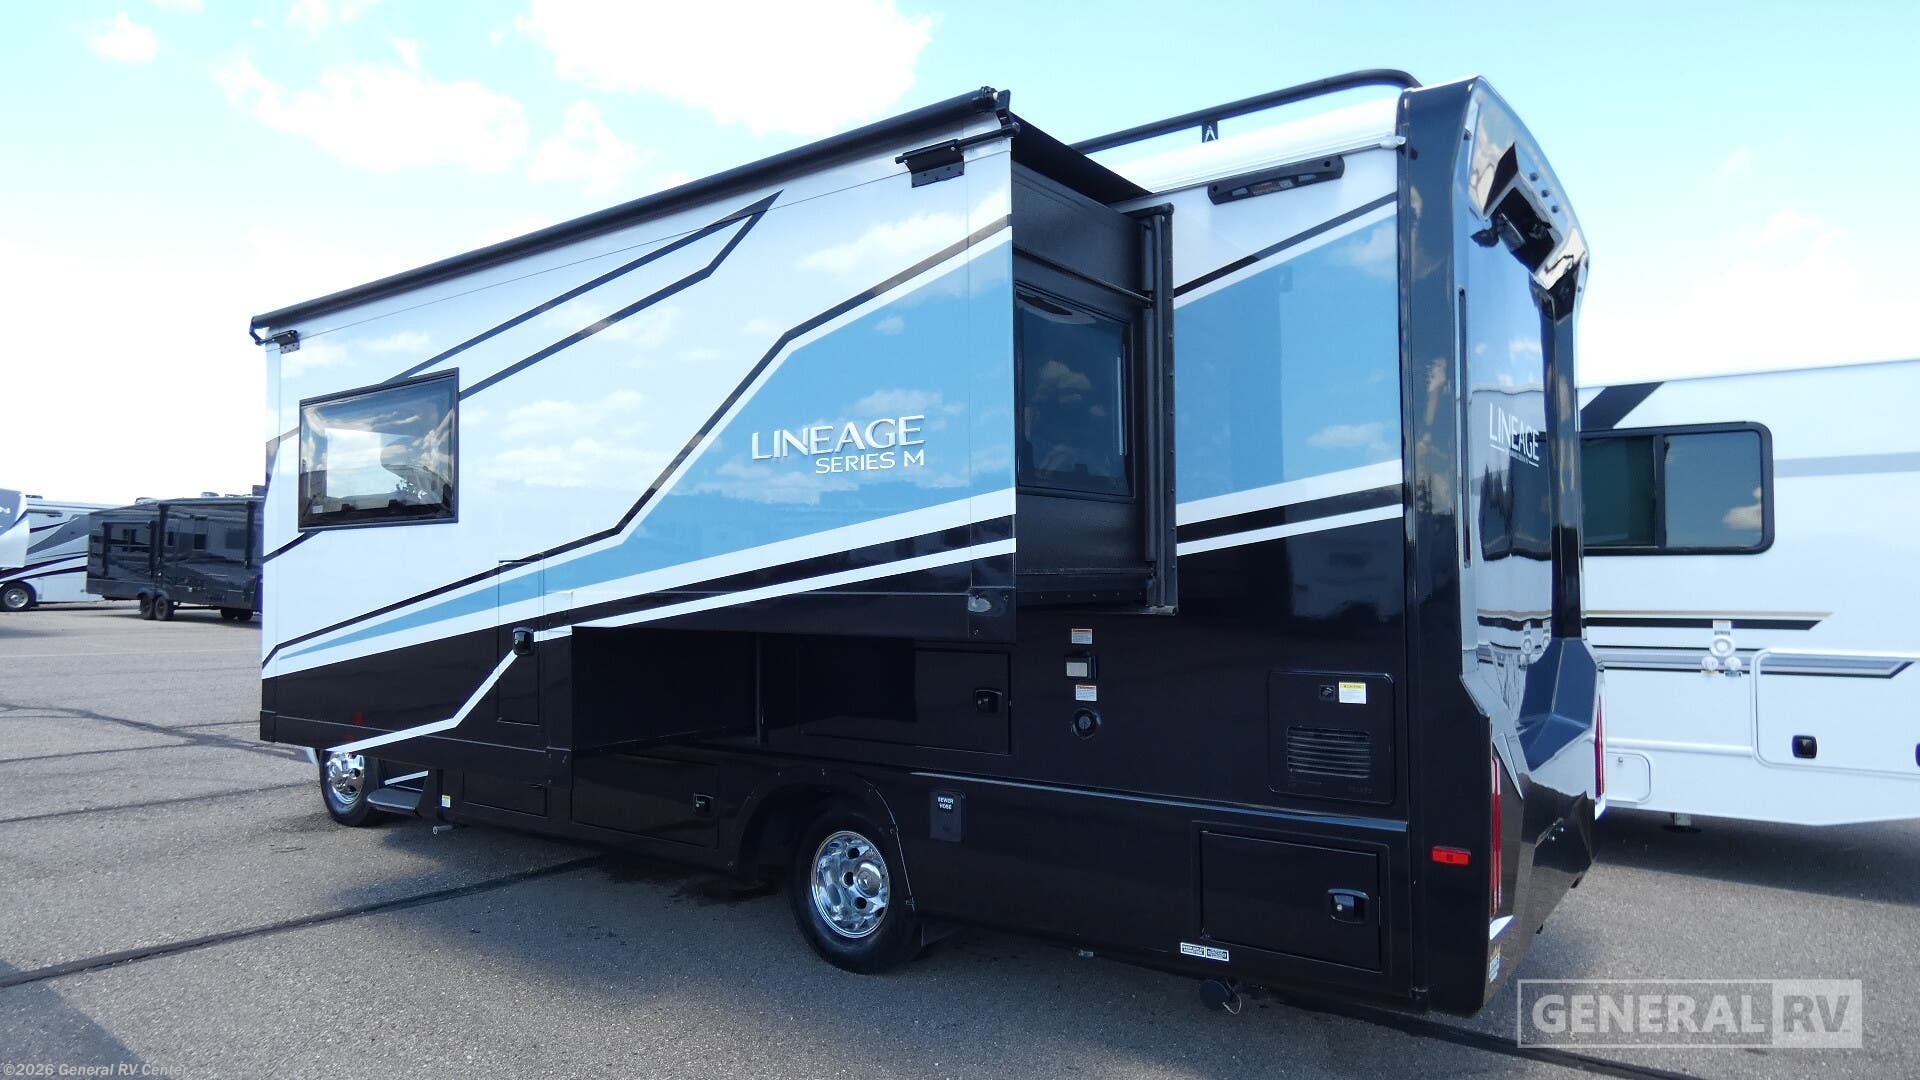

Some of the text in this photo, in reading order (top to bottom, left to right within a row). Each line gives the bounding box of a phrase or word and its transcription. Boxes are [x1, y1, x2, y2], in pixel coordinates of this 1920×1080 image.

[752, 415, 925, 460] LINEAGE
[1489, 402, 1539, 461] LINEAGE
[815, 449, 925, 474] SERIES M
